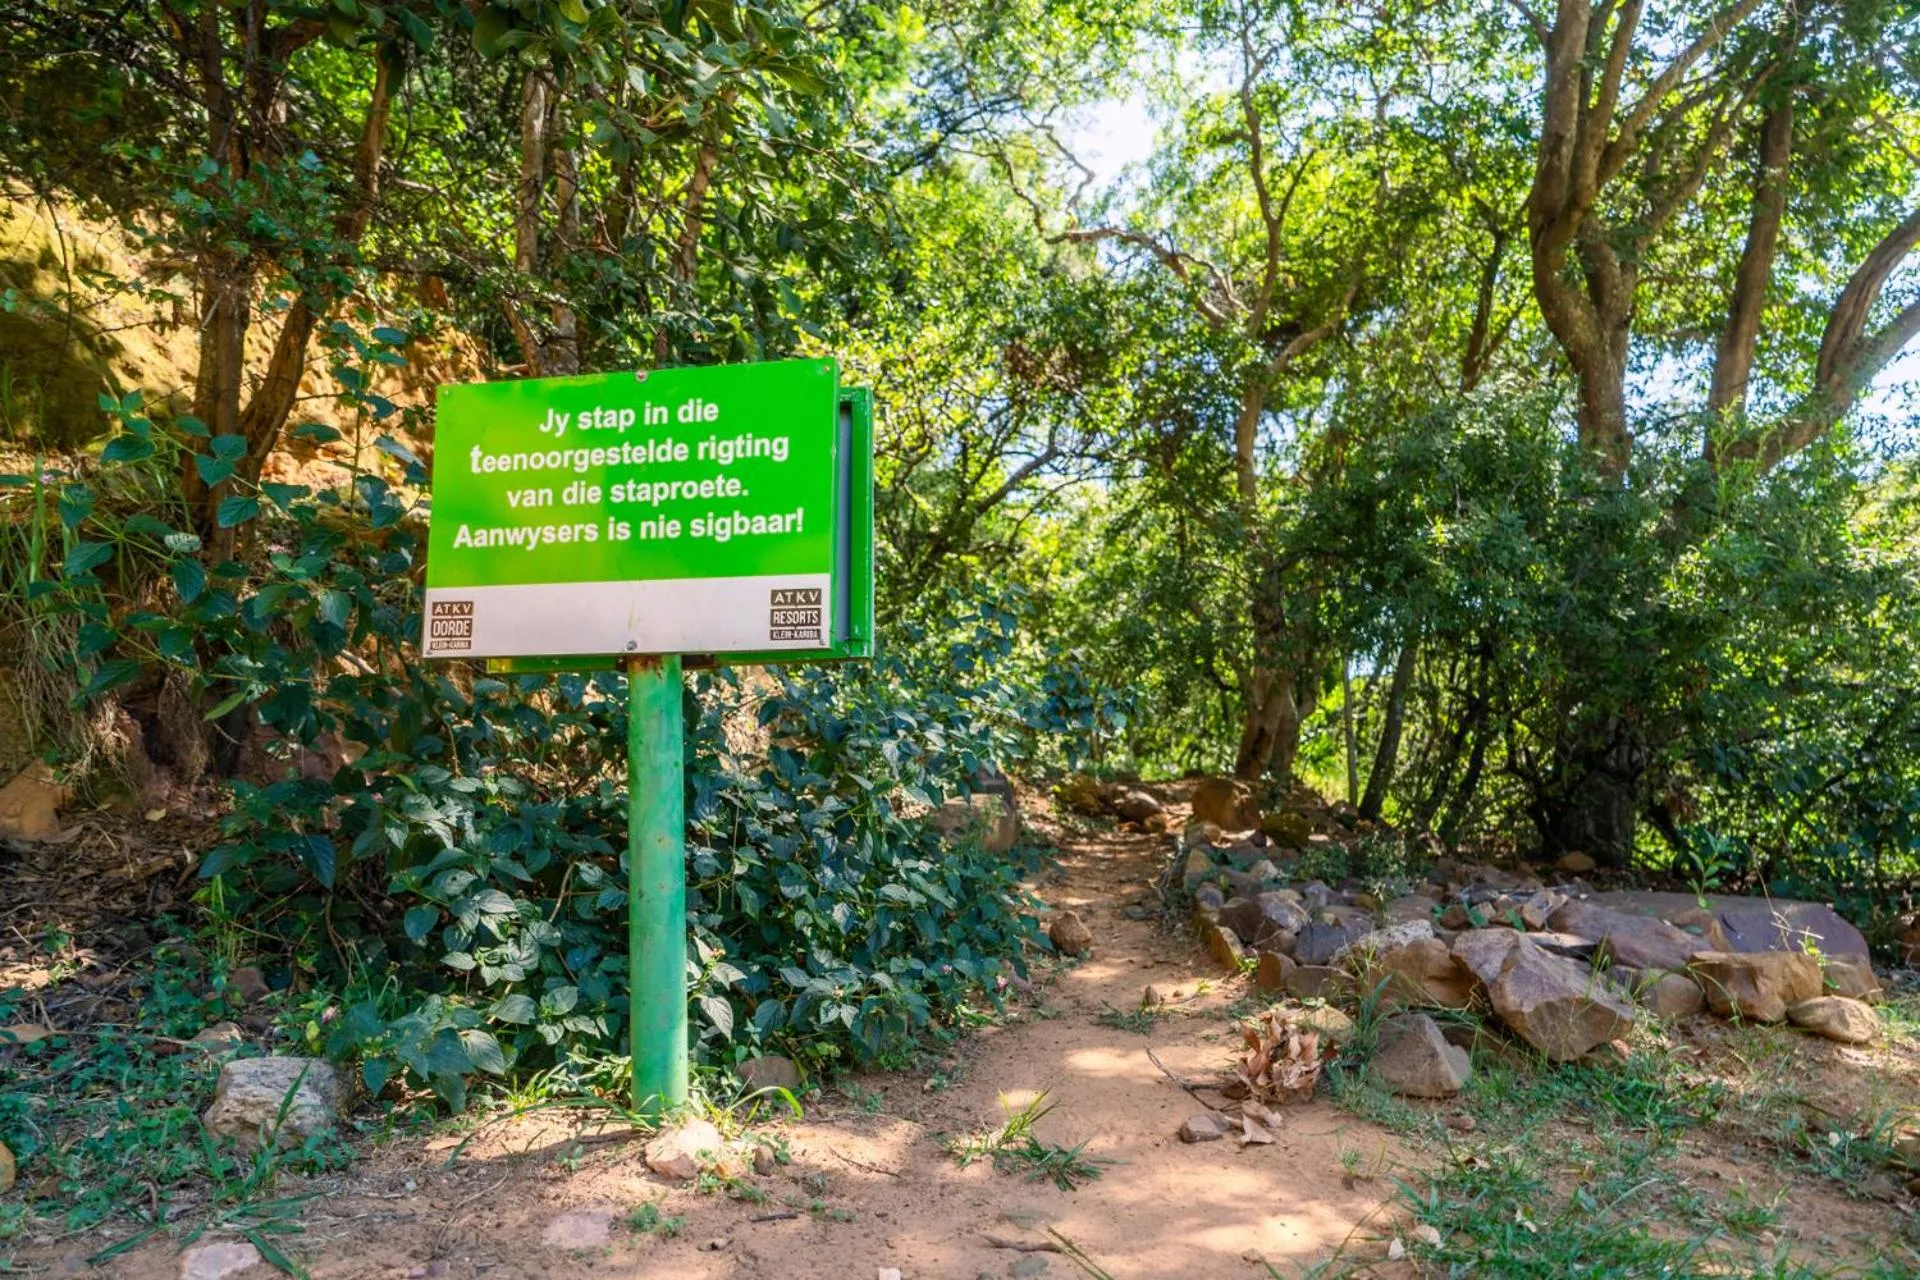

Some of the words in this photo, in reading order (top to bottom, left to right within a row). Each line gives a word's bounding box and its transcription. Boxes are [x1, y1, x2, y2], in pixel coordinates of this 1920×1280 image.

[539, 408, 570, 437] Jy
[578, 406, 636, 433] stap
[645, 401, 669, 425] in
[677, 398, 719, 424] die
[471, 438, 689, 474] teenoorgestelde
[699, 433, 789, 465] rigting
[507, 488, 553, 508] van
[562, 481, 602, 505] die
[610, 475, 749, 506] staproete.
[453, 523, 599, 551] Aanwysers
[609, 516, 631, 541] is
[640, 514, 682, 539] nie
[690, 508, 804, 543] sigbaar!
[434, 603, 472, 614] ATKV
[774, 591, 819, 604] ATKV
[432, 619, 471, 636] OORDE
[773, 610, 819, 625] RESORTS
